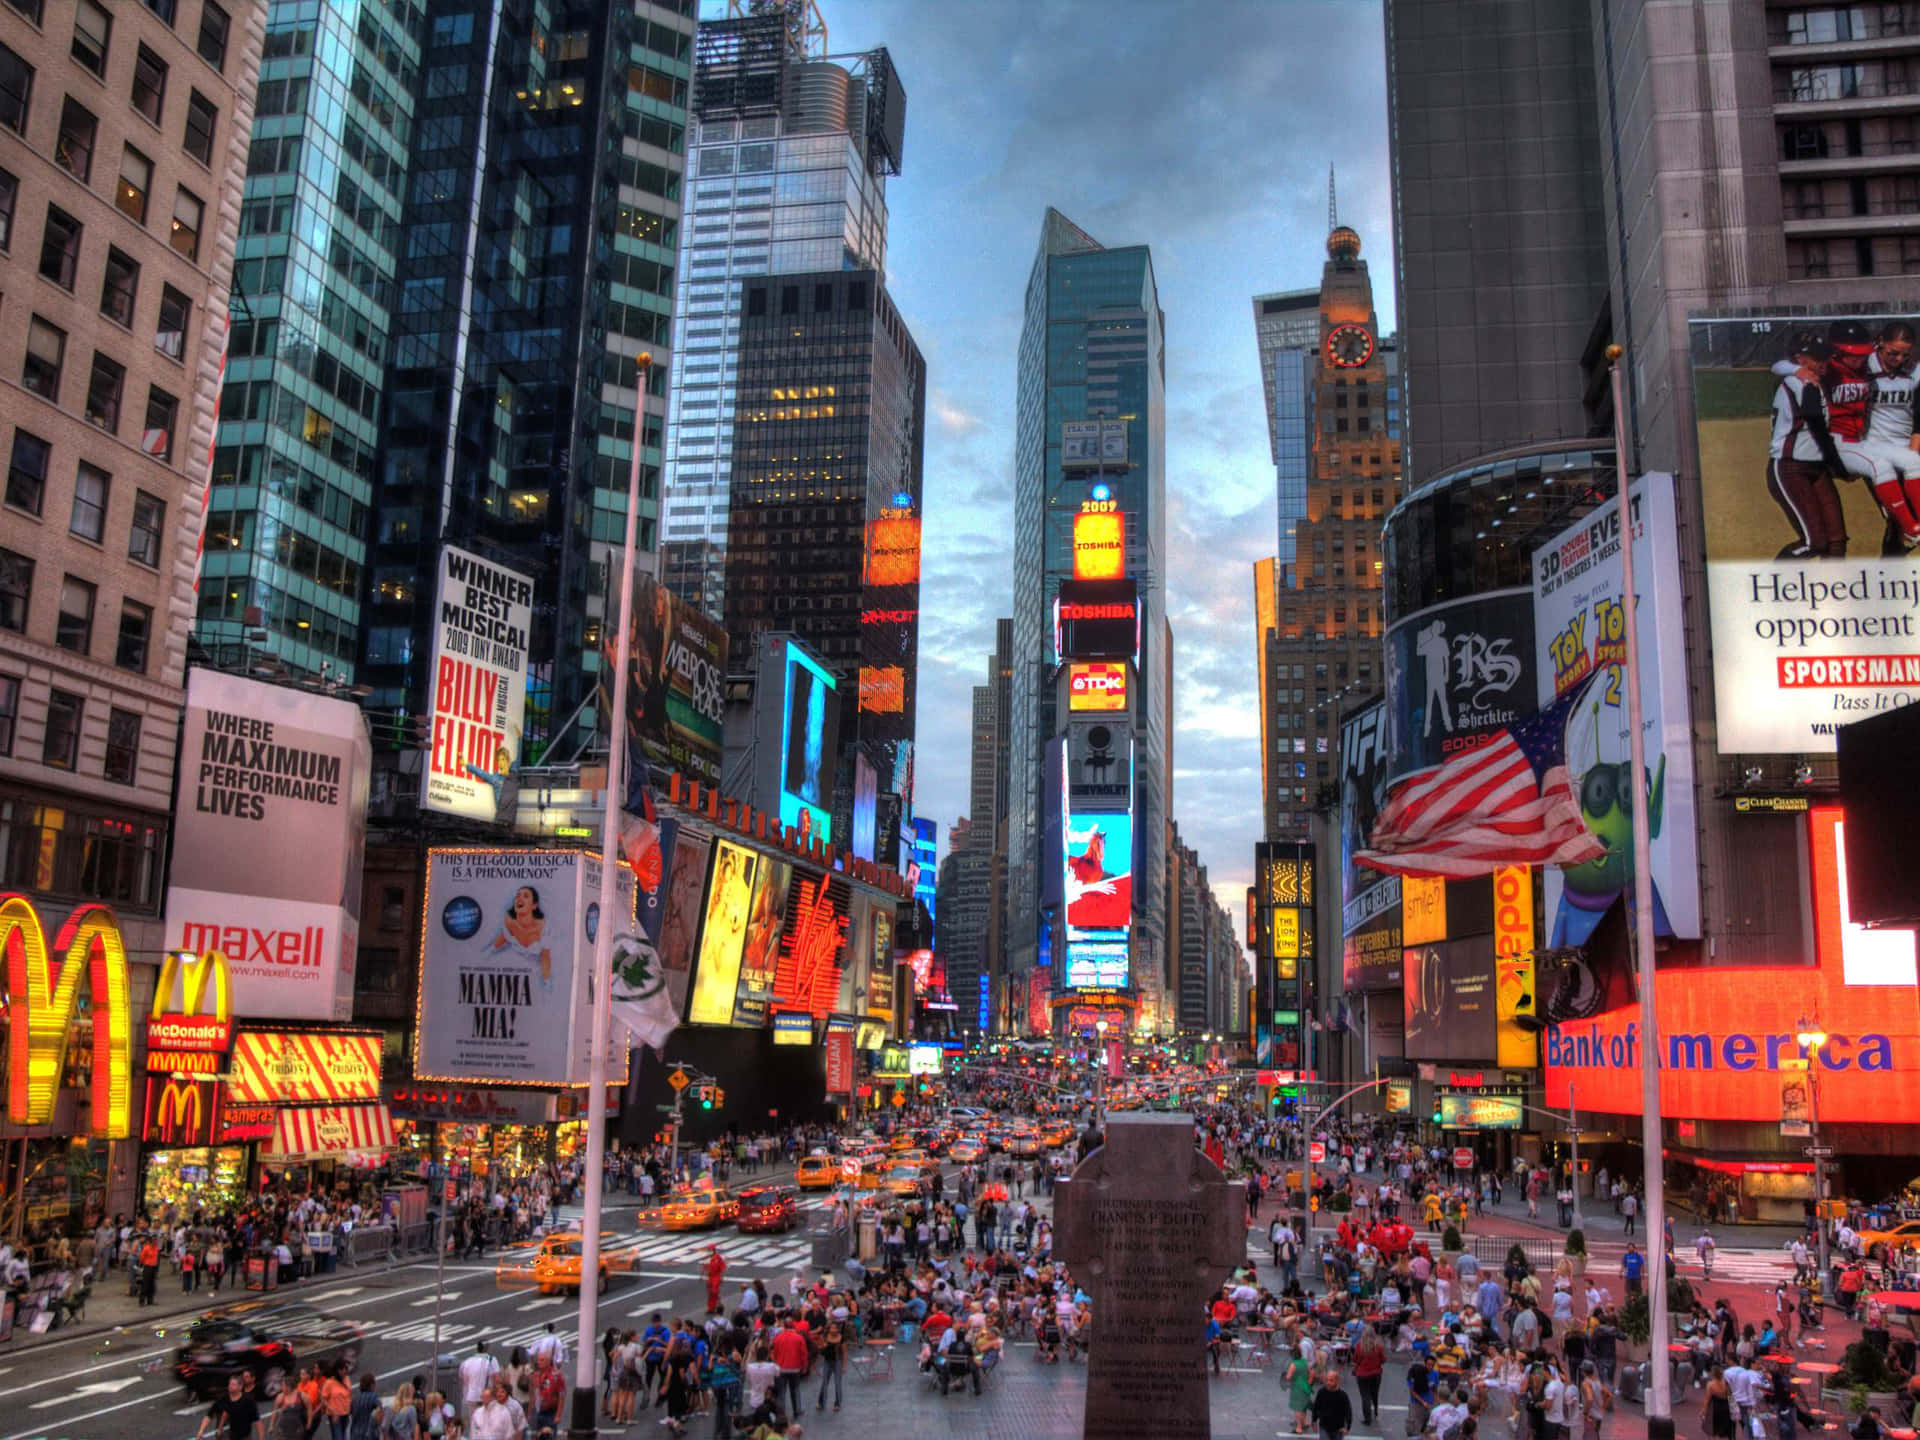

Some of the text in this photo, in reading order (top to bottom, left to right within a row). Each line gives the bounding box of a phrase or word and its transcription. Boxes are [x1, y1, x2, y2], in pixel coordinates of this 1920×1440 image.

[1082, 501, 1118, 513] 2009
[1077, 542, 1122, 550] TOSHIBA
[1541, 492, 1641, 581] 3D EVET
[1561, 543, 1590, 569] FEATURE
[447, 551, 531, 608] WINNER
[1749, 570, 1919, 610] Helped inj
[465, 585, 512, 621] BEST
[1060, 603, 1135, 619] TOSHIBA
[442, 601, 527, 651] MUSICAL
[1549, 607, 1587, 677] TOY
[1755, 613, 1914, 647] opponent
[446, 627, 520, 673] 2009 TONY AWARD
[665, 640, 720, 694] MELROSE
[1598, 645, 1627, 661] STOR
[1085, 678, 1121, 689] TDK
[1605, 662, 1622, 708] 2
[1784, 658, 1920, 684] SPORTSMAN
[436, 655, 498, 726] BILLY
[496, 675, 510, 729] THE MUSICAL
[692, 683, 724, 726] PLACE
[1833, 693, 1869, 710] Pass
[1875, 693, 1888, 710] It
[206, 709, 274, 742] WHERE
[202, 732, 341, 785] MAXIMUM
[431, 714, 504, 784] ELLIOT
[200, 763, 338, 805] PERFORMANCE
[196, 785, 265, 821] LIVES
[452, 867, 462, 878] IS
[464, 867, 473, 878] A
[466, 854, 525, 866] FEEL-GOOD
[529, 855, 576, 866] MUSICAL
[1408, 886, 1440, 919] smile?
[1276, 927, 1296, 938] LION
[1280, 917, 1293, 926] THE
[1495, 863, 1530, 989] Kodak
[183, 921, 323, 967] maxell
[1276, 939, 1296, 951] KING
[458, 973, 532, 1006] MAMMA
[149, 1024, 225, 1039] McDonald's
[472, 1007, 516, 1039] MIA!
[160, 1038, 212, 1048] Restaurant
[1547, 1022, 1893, 1071] Bank of merca
